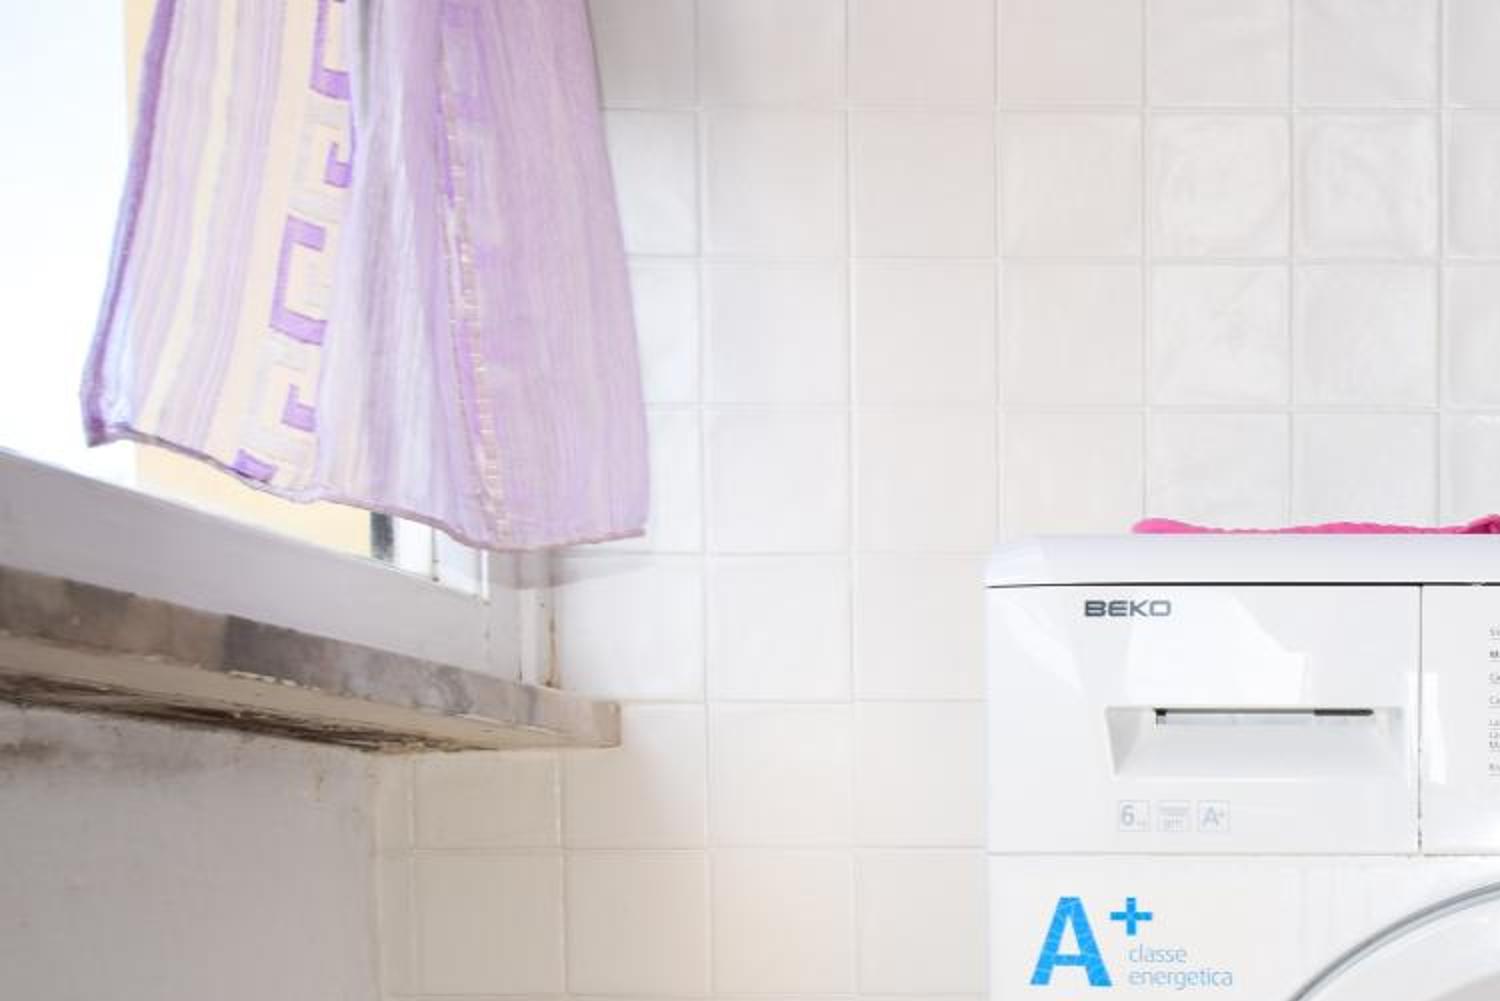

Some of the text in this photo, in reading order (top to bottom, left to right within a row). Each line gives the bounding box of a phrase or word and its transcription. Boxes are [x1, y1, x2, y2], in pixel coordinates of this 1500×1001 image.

[1085, 600, 1171, 617] BEKO
[1121, 804, 1135, 827] 6
[1030, 896, 1153, 987] A+
[1128, 944, 1188, 964] classe
[1128, 967, 1234, 990] energetica
